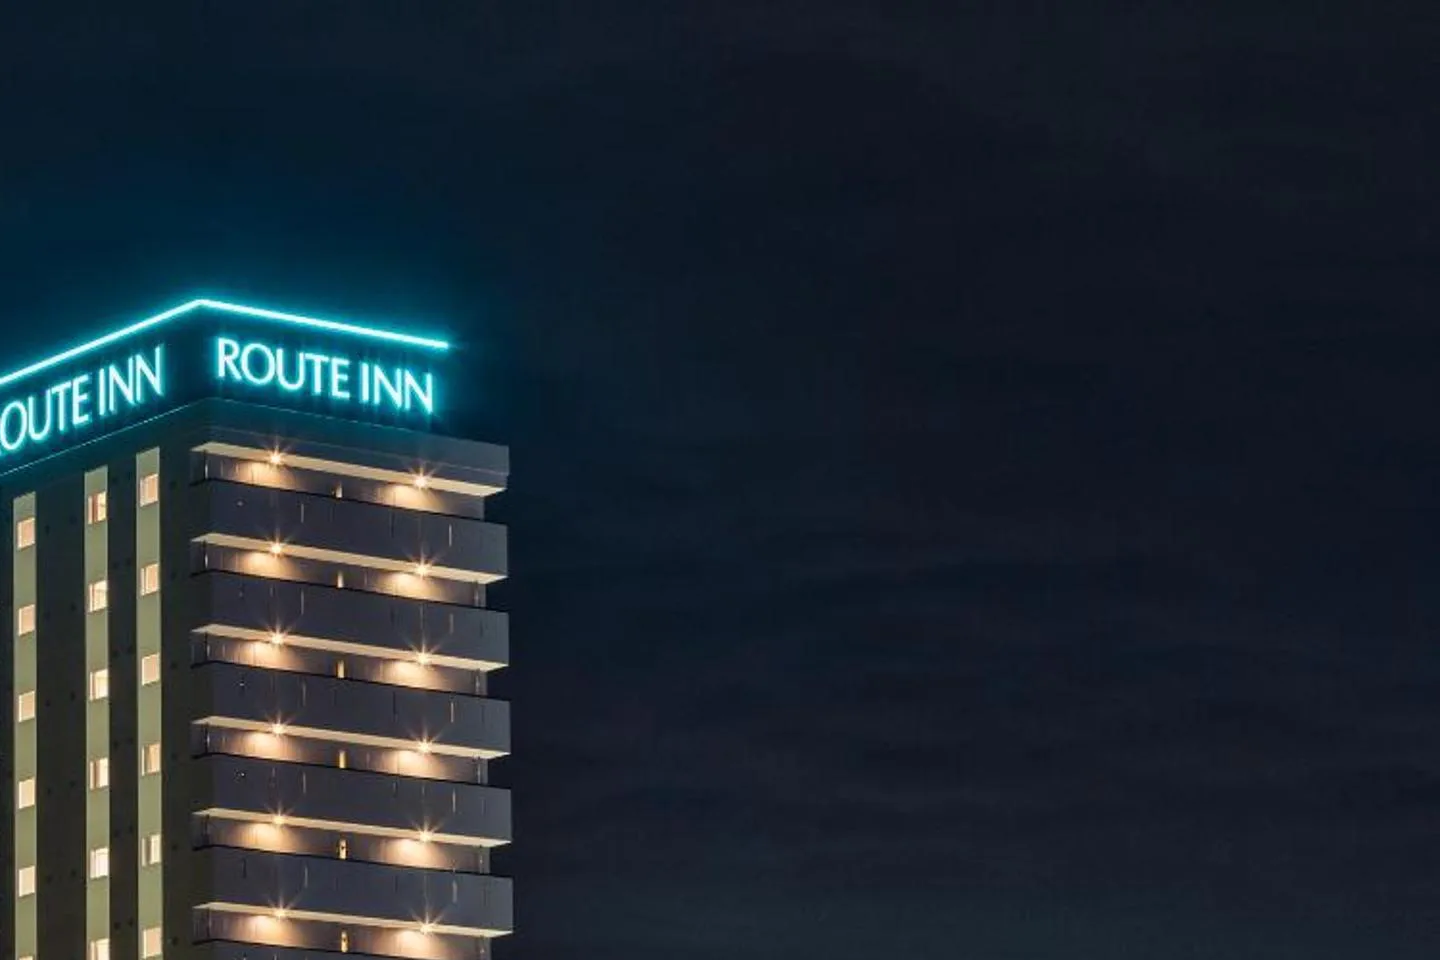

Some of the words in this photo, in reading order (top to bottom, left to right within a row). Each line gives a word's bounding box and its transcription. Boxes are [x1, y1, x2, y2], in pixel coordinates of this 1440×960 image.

[98, 344, 164, 417] INN
[217, 337, 350, 399] ROUTE
[361, 362, 433, 415] INN
